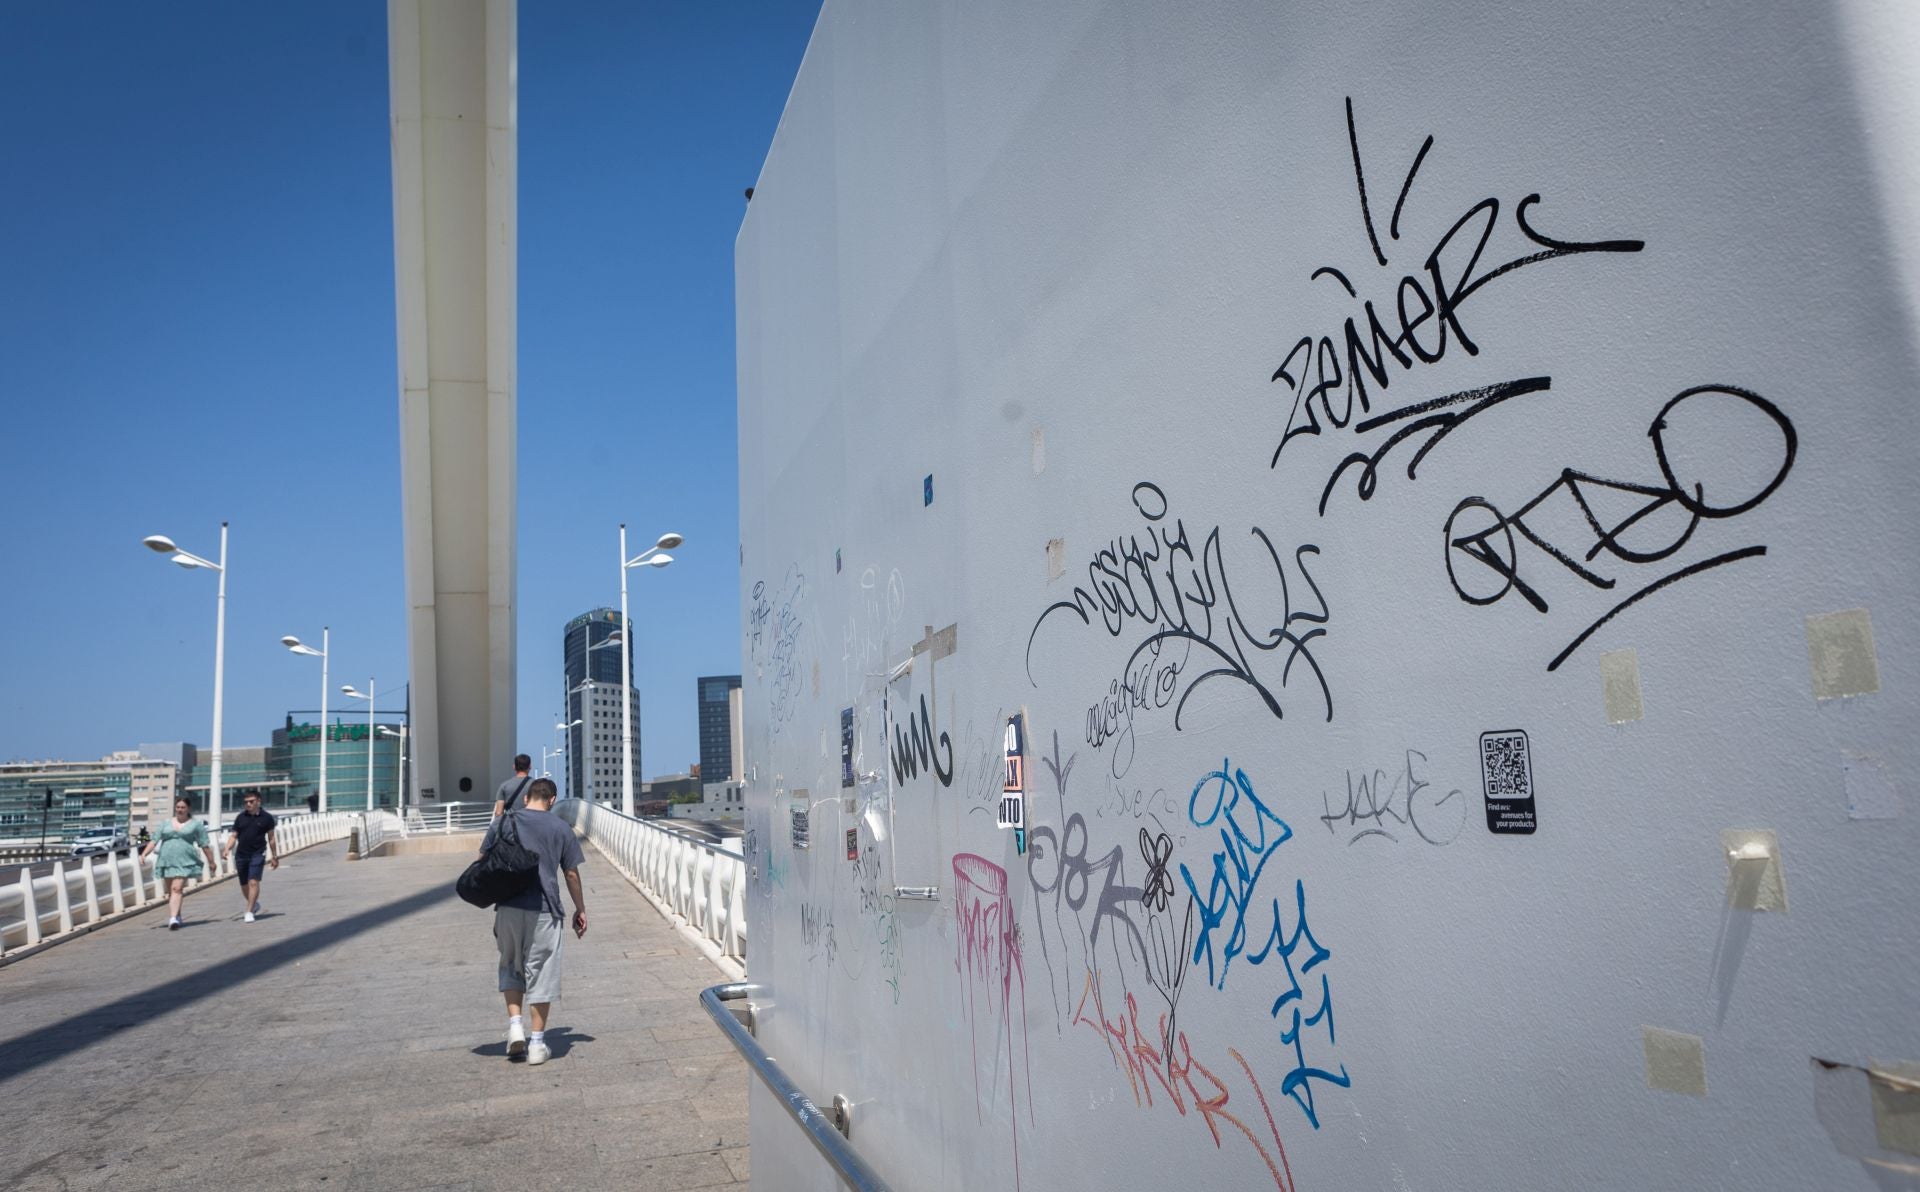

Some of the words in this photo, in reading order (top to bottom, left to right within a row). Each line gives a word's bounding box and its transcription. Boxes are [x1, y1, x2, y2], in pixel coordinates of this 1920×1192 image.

[1524, 811, 1533, 819] for
[1495, 821, 1508, 829] your
[1508, 820, 1535, 829] products
